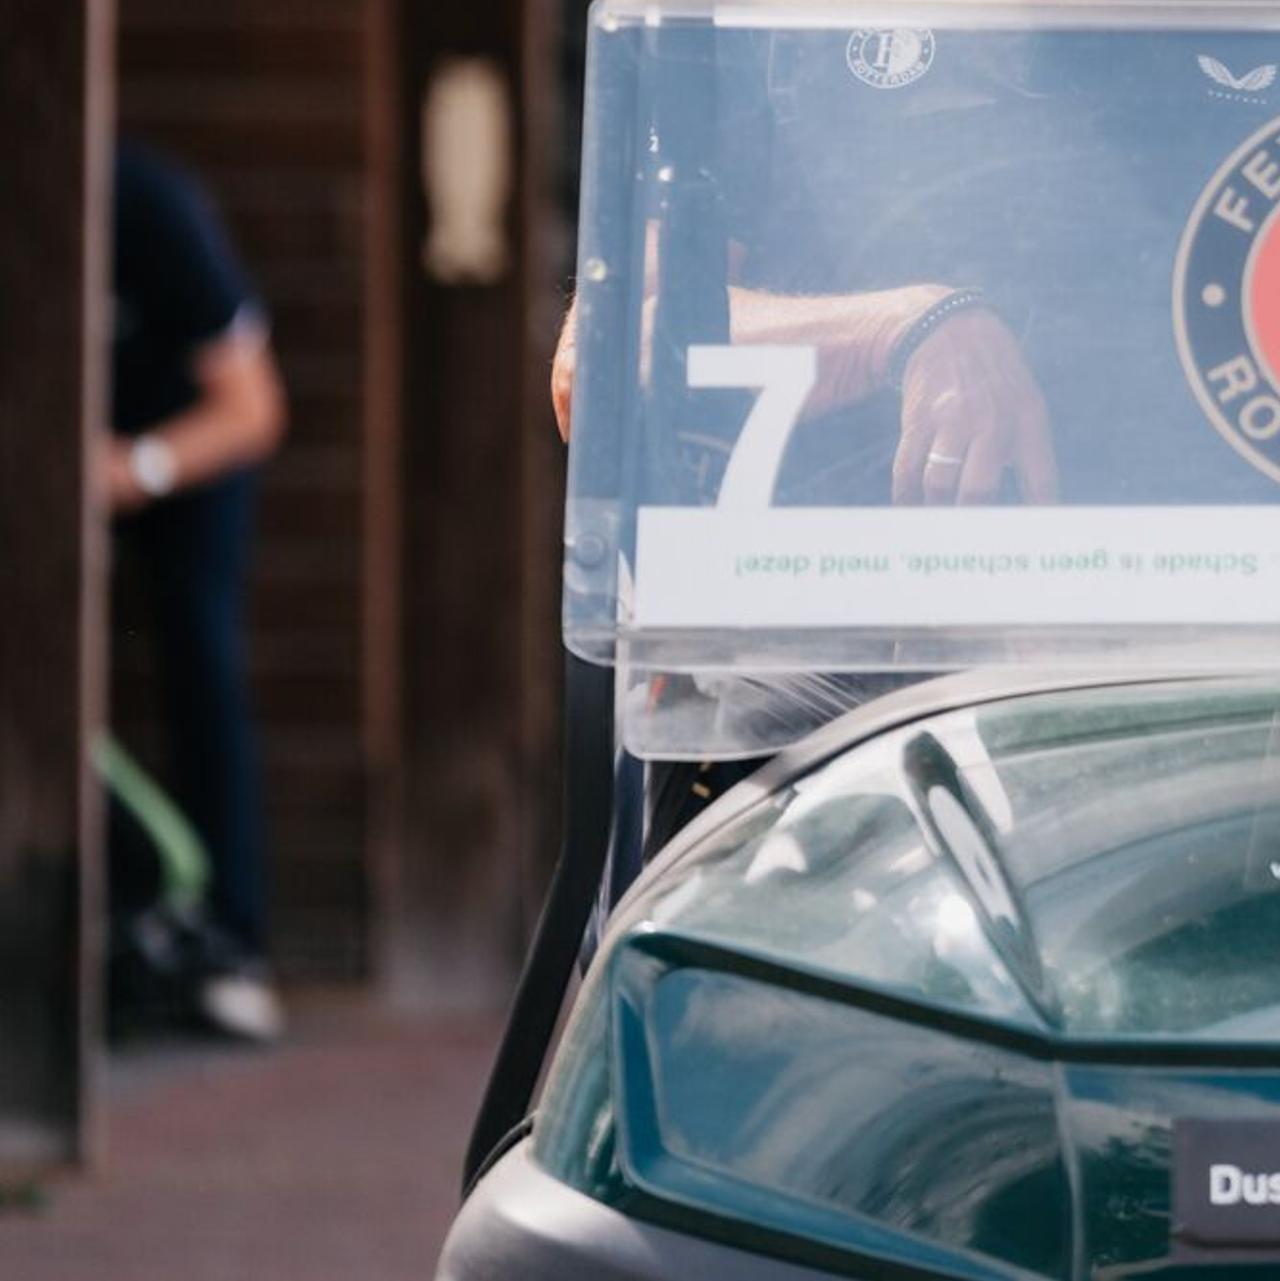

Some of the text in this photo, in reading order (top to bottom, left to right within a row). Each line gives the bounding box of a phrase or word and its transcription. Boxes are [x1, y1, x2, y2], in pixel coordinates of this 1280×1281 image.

[686, 345, 818, 508] 7
[735, 553, 811, 578] deze!
[819, 553, 890, 577] meld
[1038, 549, 1109, 572] geen
[1119, 553, 1145, 573] is
[1151, 552, 1258, 576] Schade
